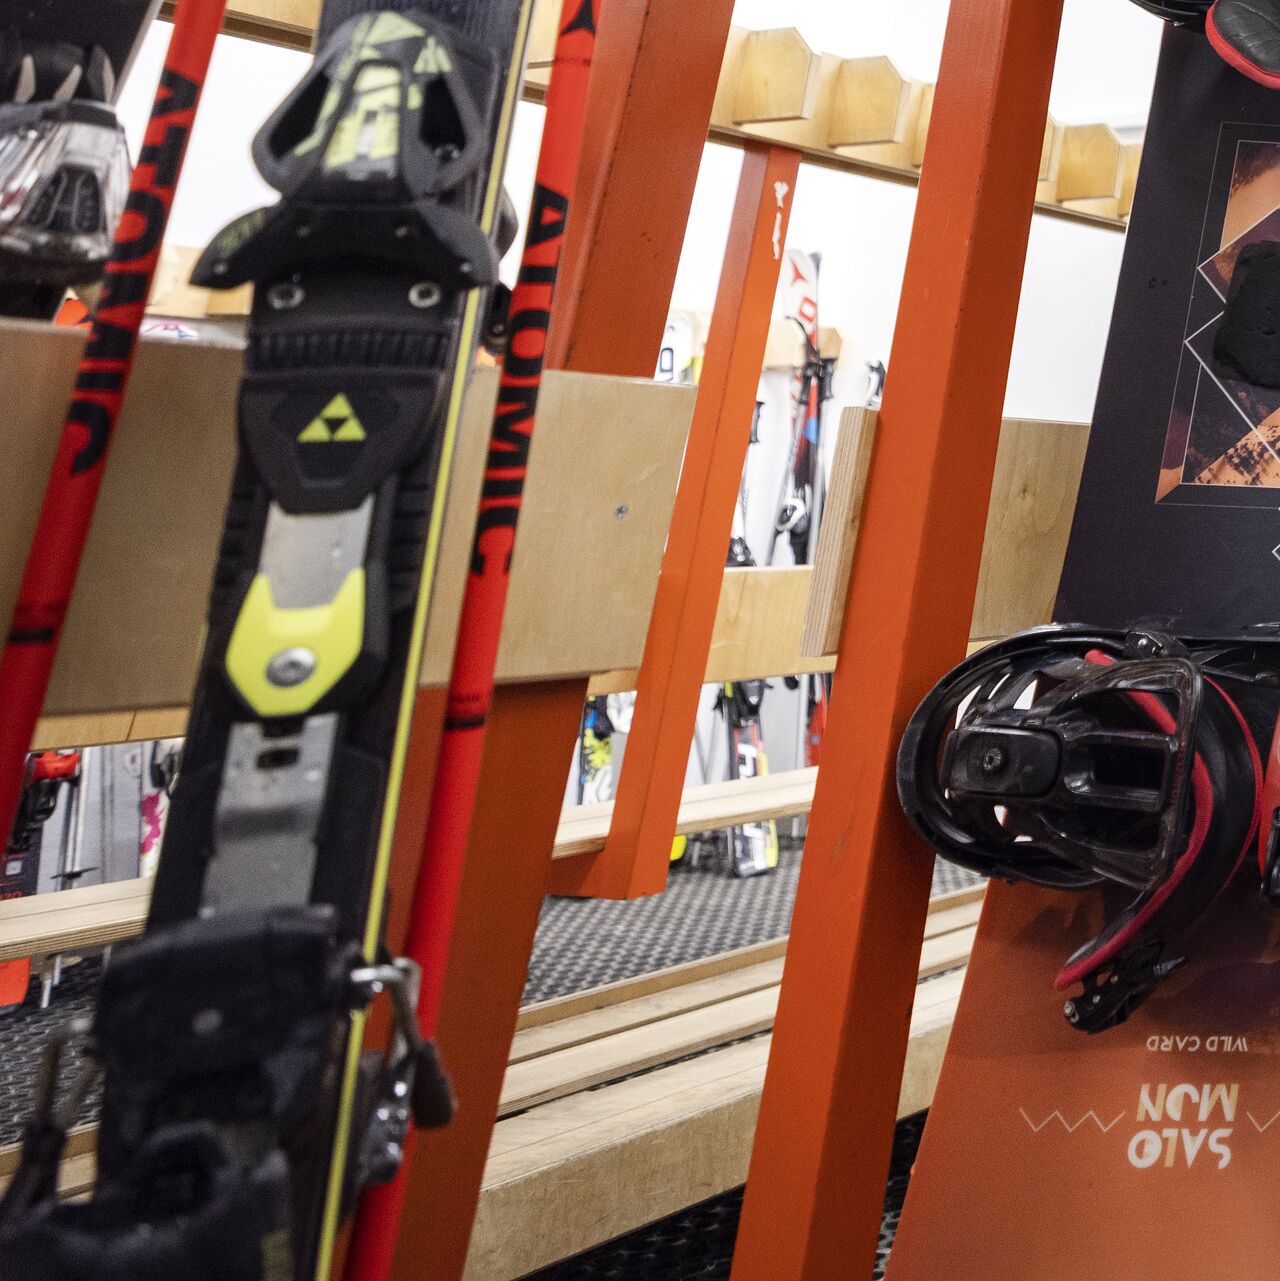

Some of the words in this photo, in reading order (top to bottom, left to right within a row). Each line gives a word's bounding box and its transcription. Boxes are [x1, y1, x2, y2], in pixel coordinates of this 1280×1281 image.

[70, 66, 201, 476] ATOMIC
[472, 186, 570, 576] ATOMIC
[1146, 1035, 1200, 1052] CARD
[1205, 1035, 1249, 1052] WILD
